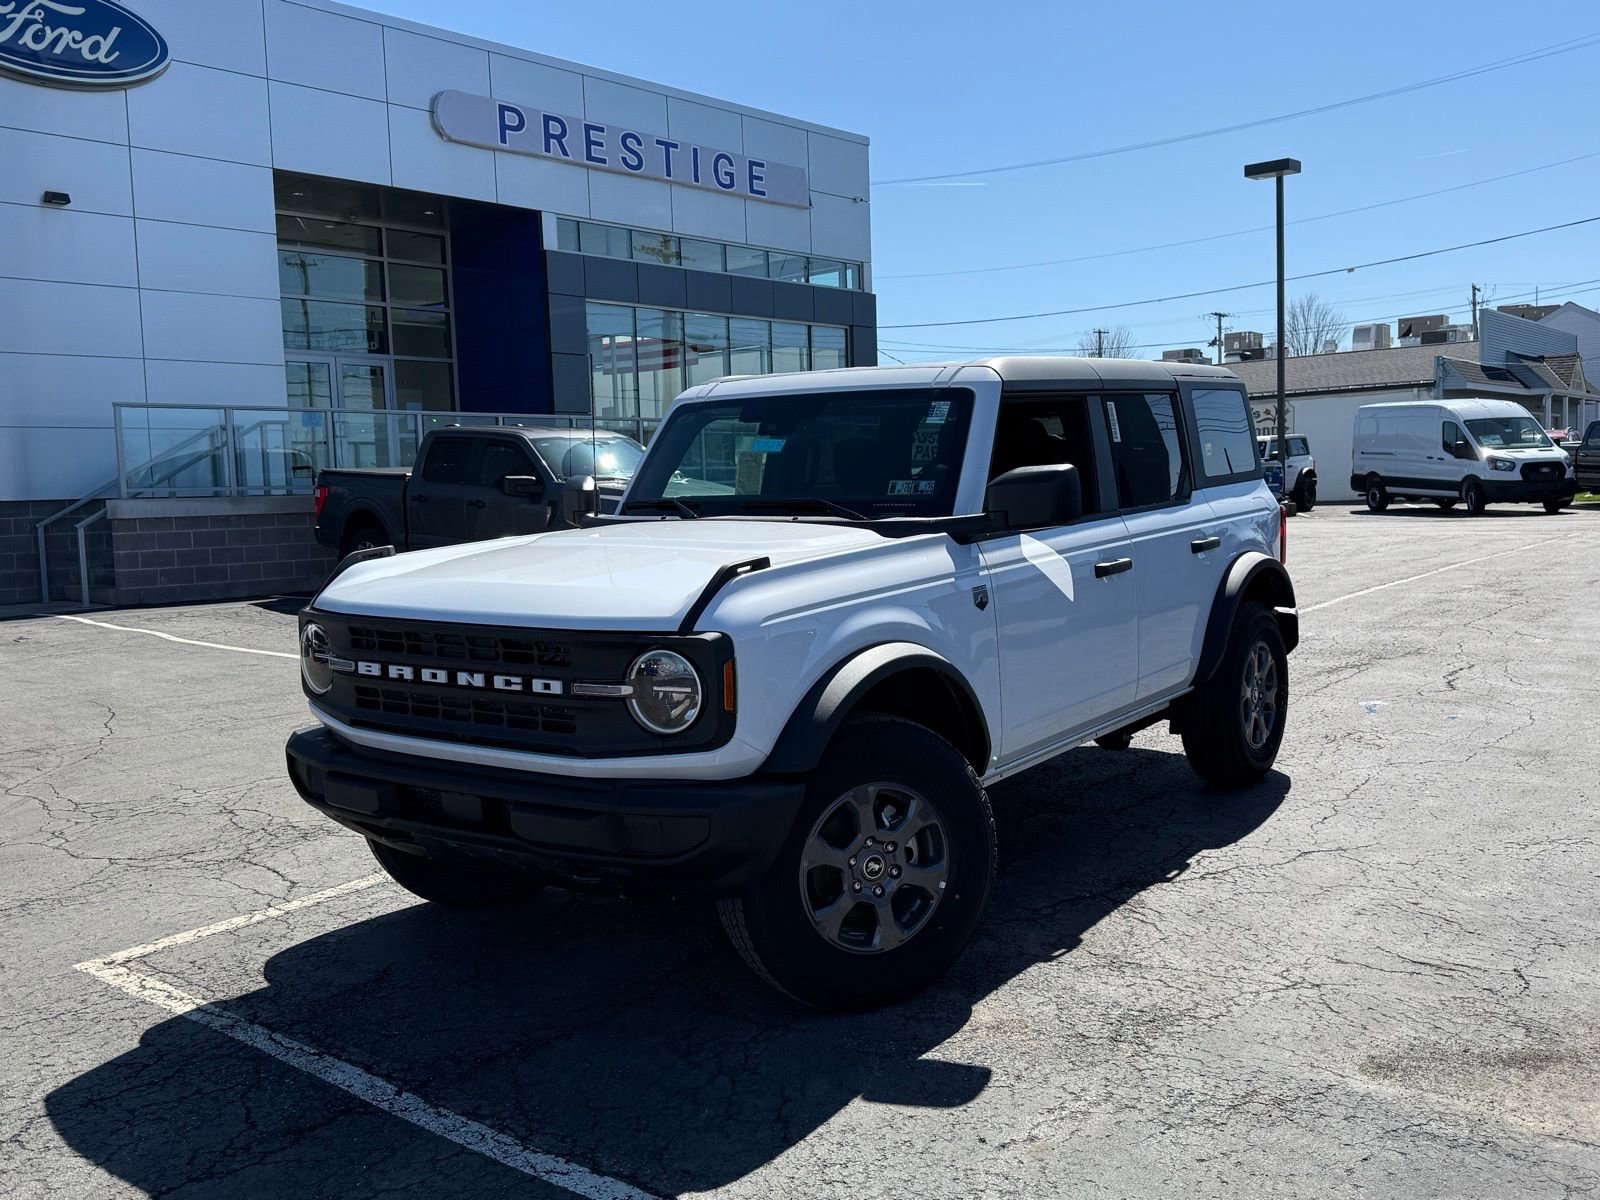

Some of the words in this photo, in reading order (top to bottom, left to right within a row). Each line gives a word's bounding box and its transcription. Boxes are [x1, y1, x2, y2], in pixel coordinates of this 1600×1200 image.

[0, 0, 122, 64] Ford
[498, 103, 768, 196] PRESTIGE
[358, 662, 563, 694] BRONCO
